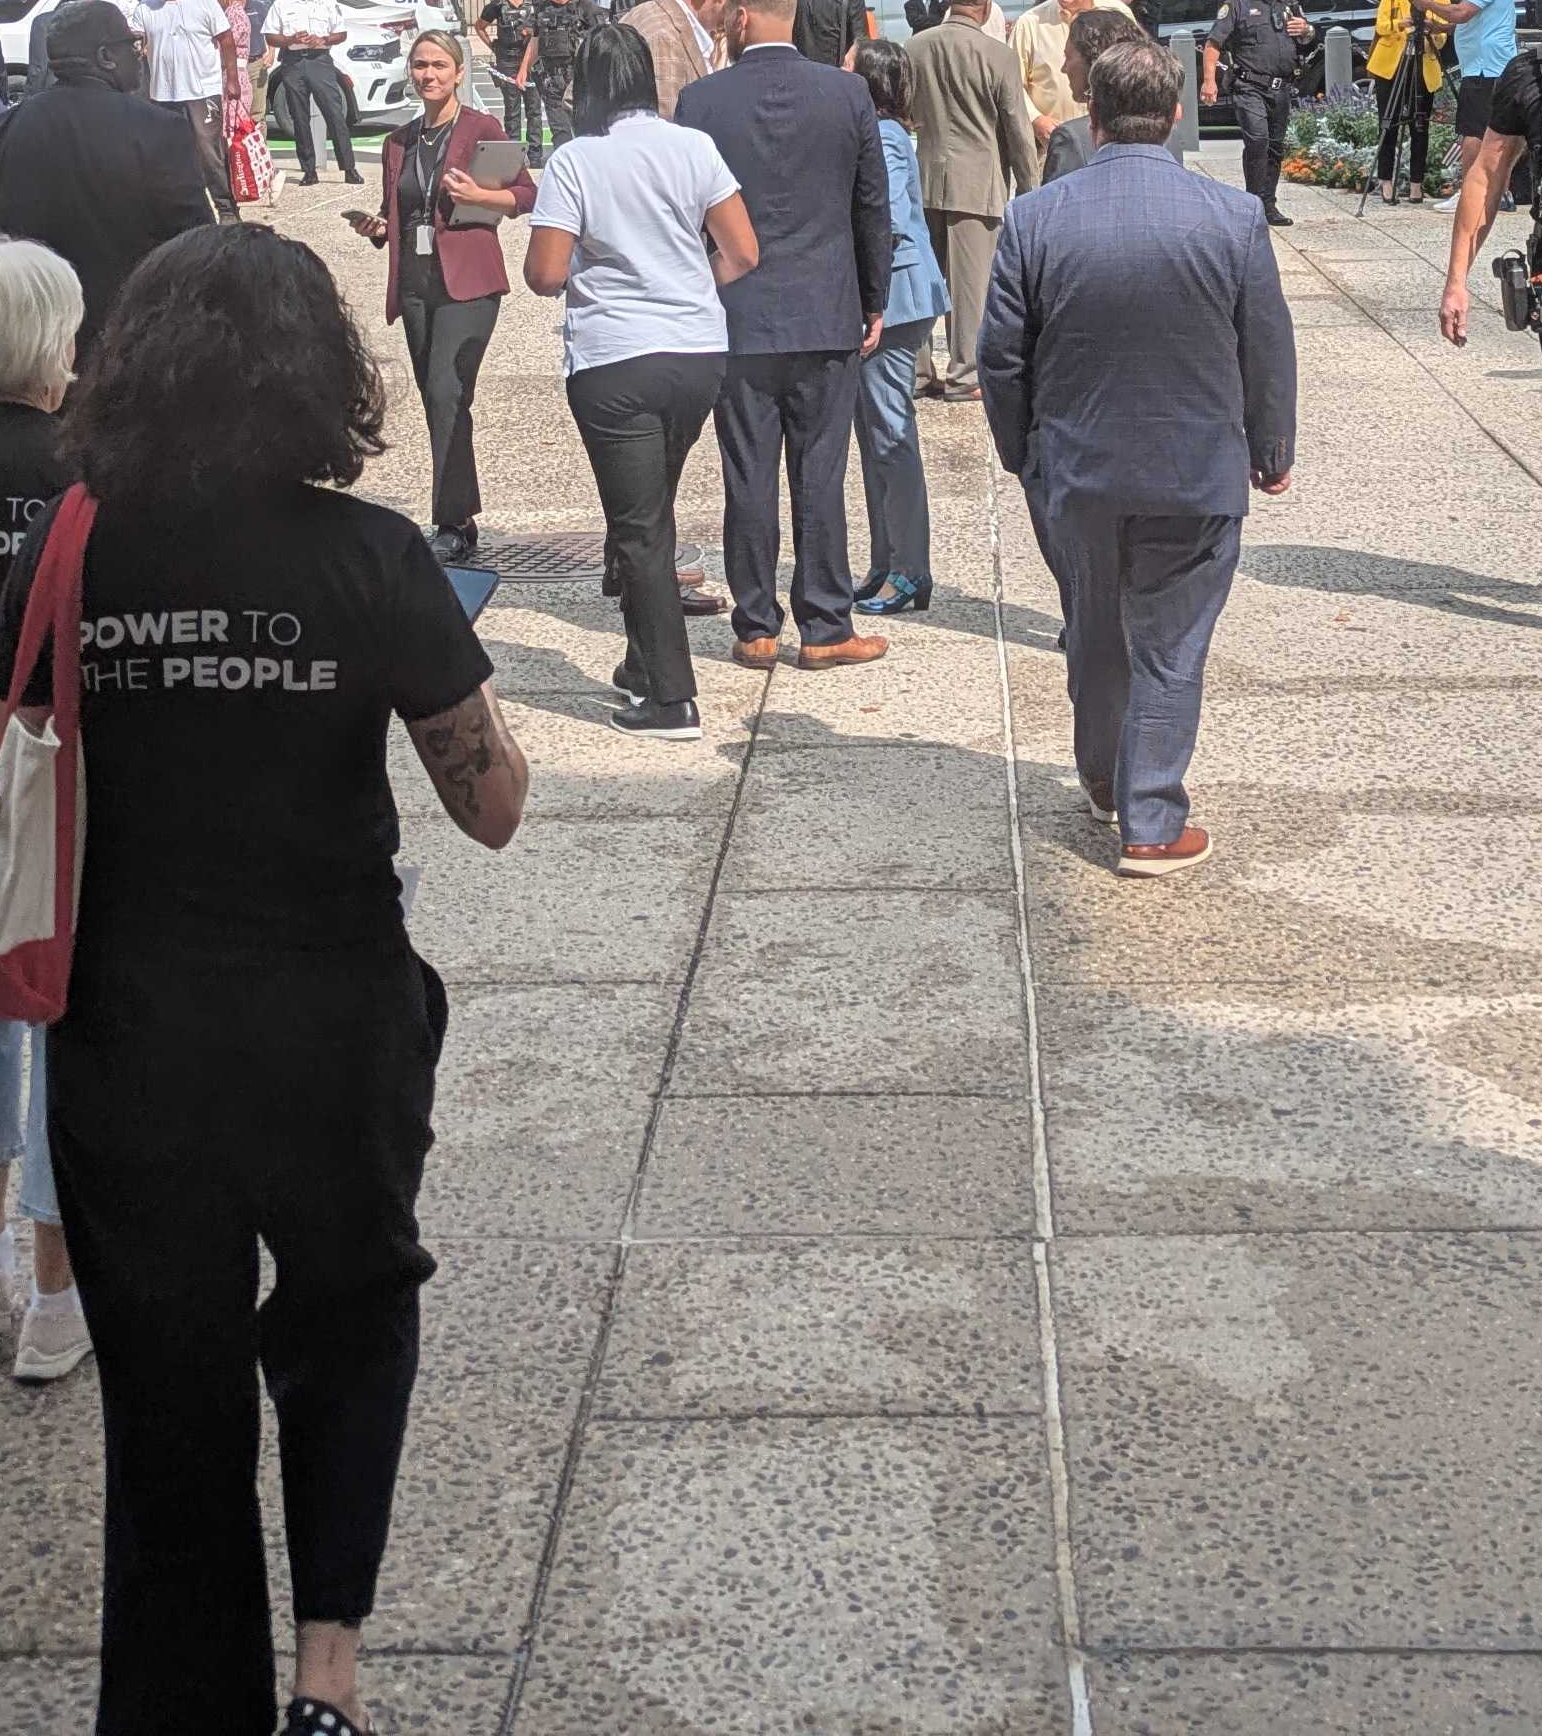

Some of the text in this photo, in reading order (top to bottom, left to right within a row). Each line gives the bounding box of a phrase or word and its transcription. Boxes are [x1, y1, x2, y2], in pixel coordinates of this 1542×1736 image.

[6, 497, 46, 522] TO
[80, 609, 302, 651] POWER TO
[81, 656, 338, 692] THE PEOPLE
